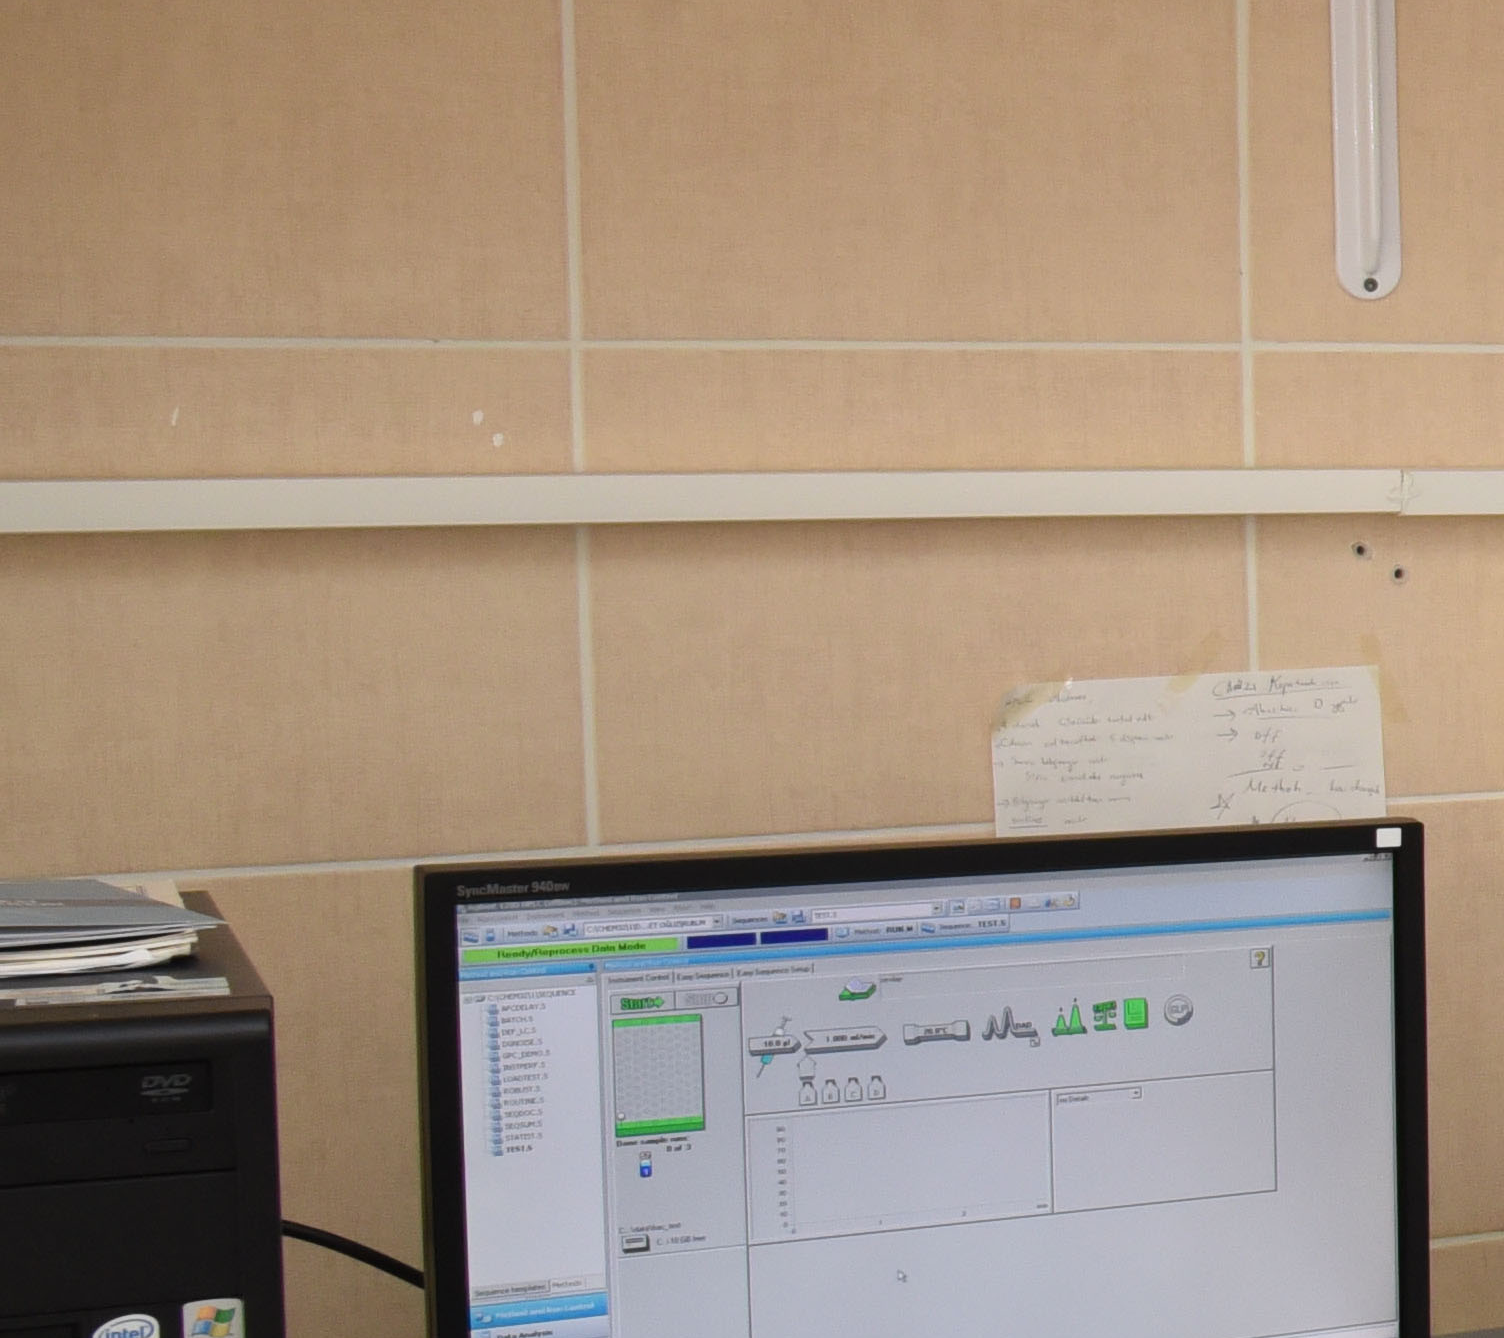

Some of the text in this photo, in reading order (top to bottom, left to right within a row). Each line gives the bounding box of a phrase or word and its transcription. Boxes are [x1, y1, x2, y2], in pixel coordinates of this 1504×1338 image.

[457, 882, 529, 898] SyncMaster
[497, 941, 646, 960] Ready/Reprocess Data Mode
